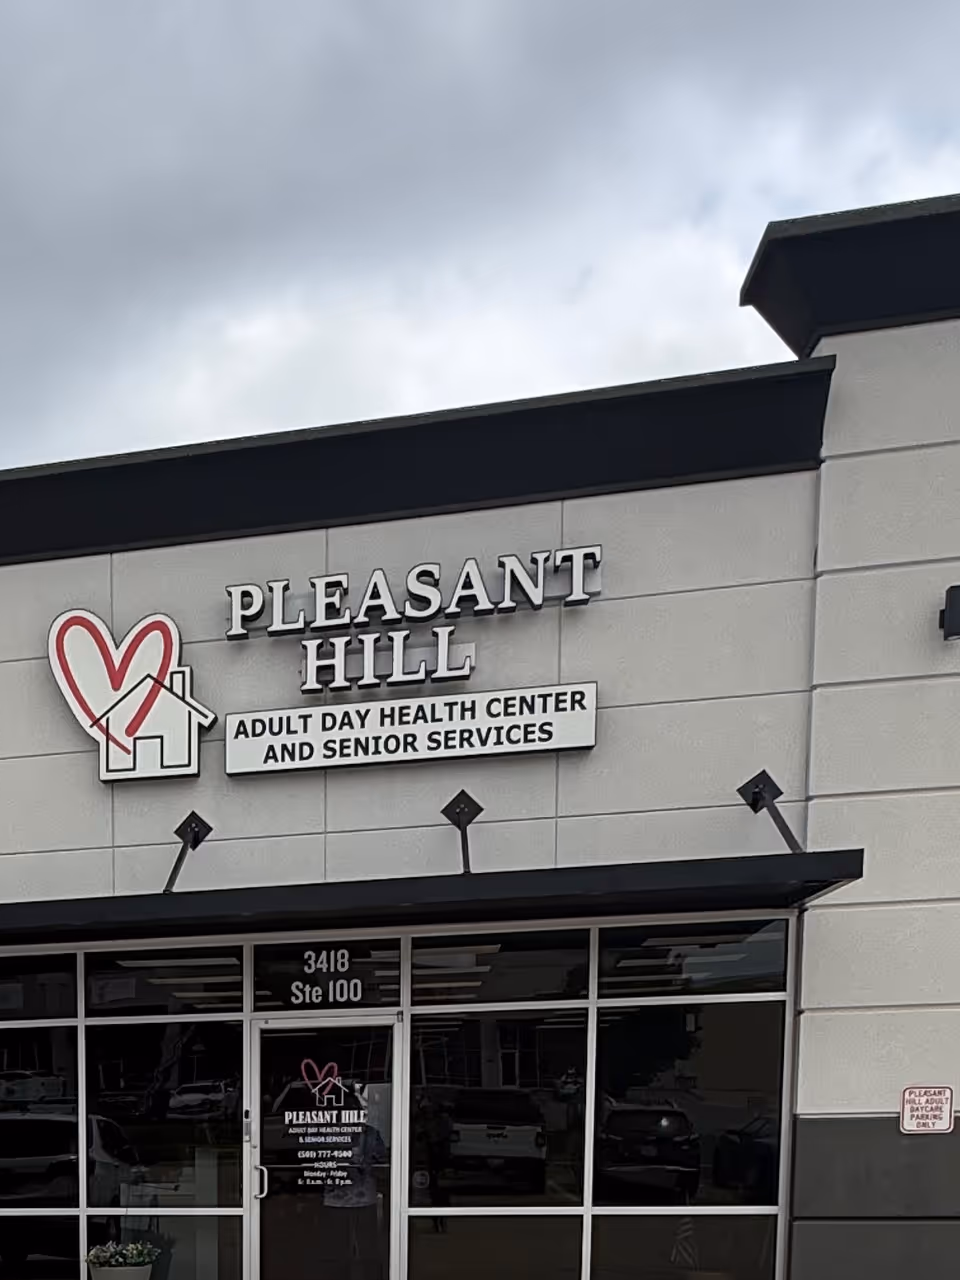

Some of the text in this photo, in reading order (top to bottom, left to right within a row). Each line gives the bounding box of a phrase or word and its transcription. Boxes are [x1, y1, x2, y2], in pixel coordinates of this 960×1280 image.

[225, 544, 601, 641] PLEASANT
[300, 625, 471, 694] HILL
[233, 690, 587, 740] ADULT DAY HEALTH CENTER
[263, 721, 554, 764] AND SENIOR SERVICES
[303, 948, 349, 974] 3418
[290, 978, 362, 1004] Ste 100
[908, 1089, 946, 1098] PLEASANT
[924, 1097, 949, 1105] ADULT
[284, 1109, 367, 1125] PLEASANT HILL
[910, 1105, 944, 1113] DAYCARE
[910, 1113, 943, 1121] PARKING
